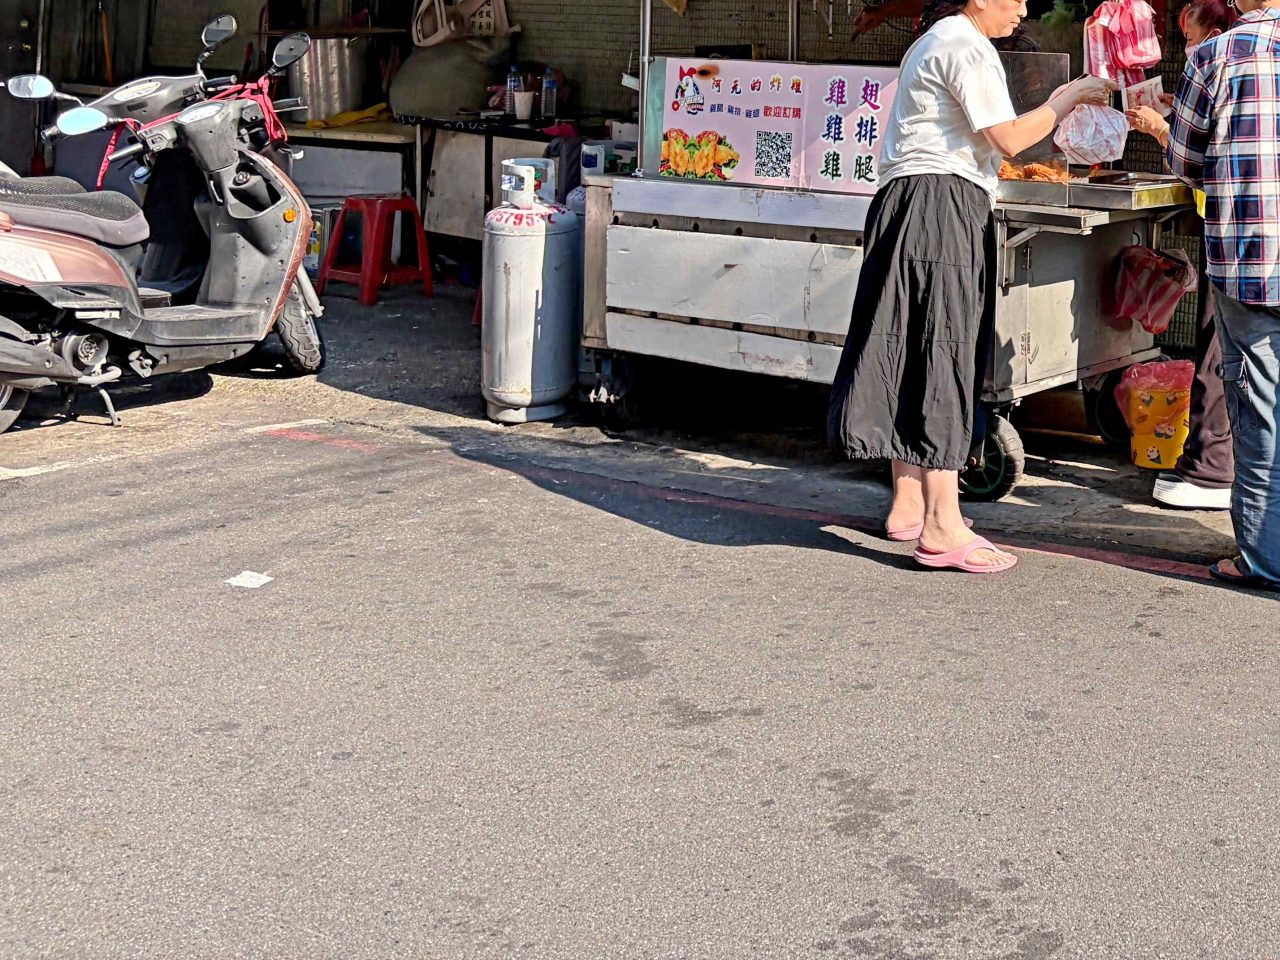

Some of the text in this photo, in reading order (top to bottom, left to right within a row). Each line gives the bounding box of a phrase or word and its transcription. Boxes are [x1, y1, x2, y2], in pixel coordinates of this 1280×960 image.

[712, 76, 802, 94] 阿元的炸雞
[826, 78, 880, 111] 雞翅
[822, 115, 878, 147] 雞排
[820, 152, 876, 183] 雞腿
